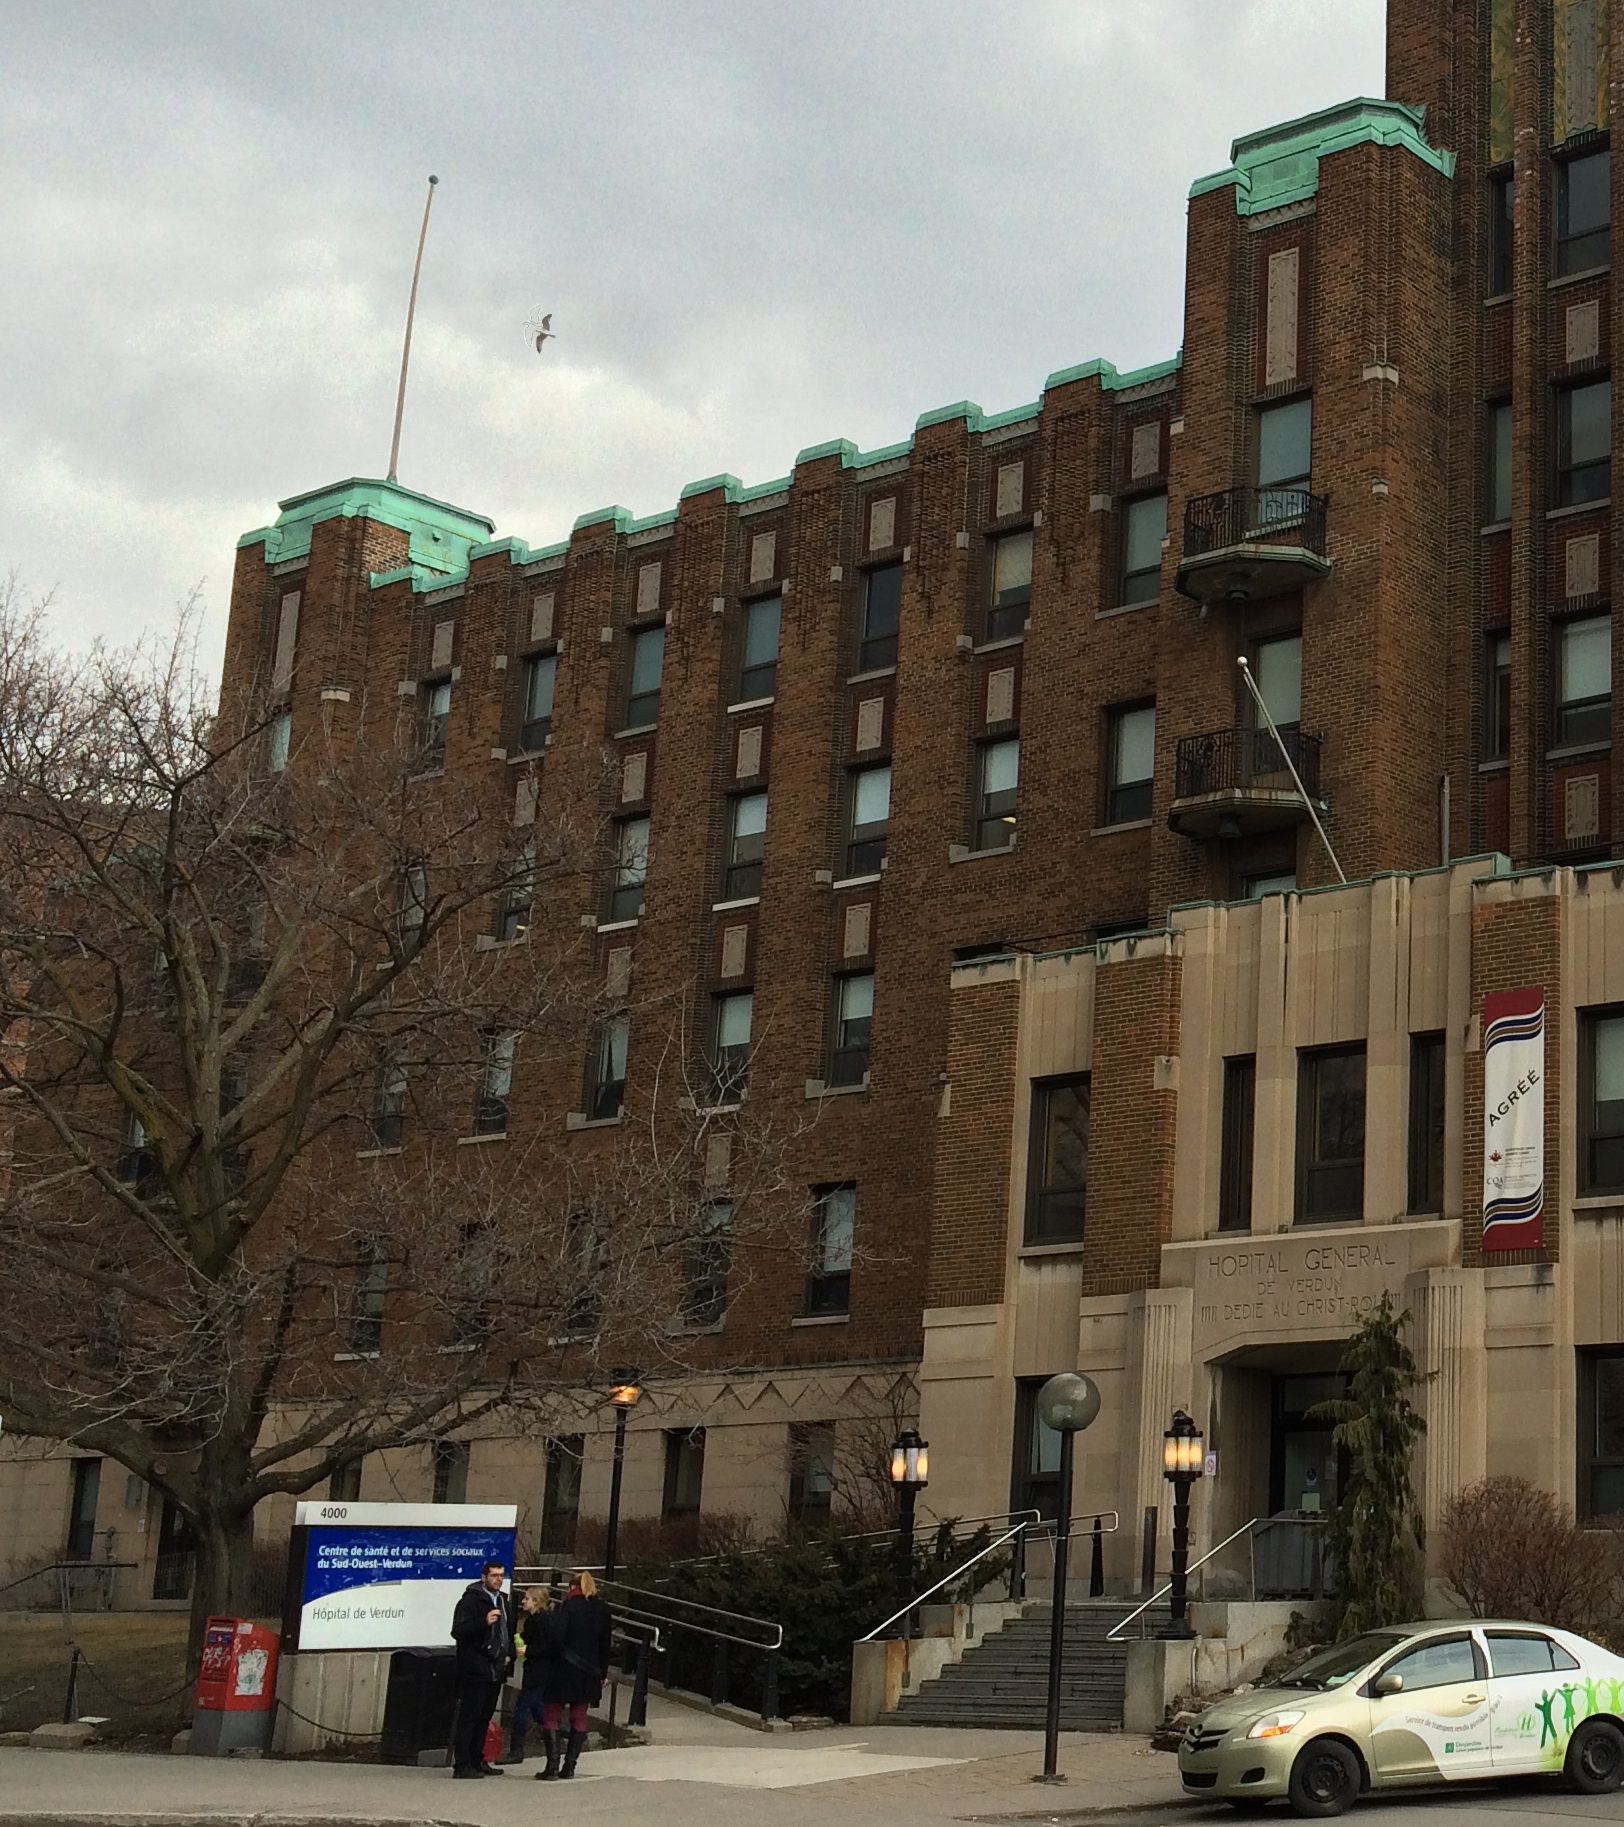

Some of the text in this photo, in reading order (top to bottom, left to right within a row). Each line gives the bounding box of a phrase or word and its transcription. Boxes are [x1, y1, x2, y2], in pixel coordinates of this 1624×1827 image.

[1488, 1069, 1540, 1127] AGRÉÉ
[1208, 1244, 1396, 1279] HOPITAL GENERAL
[1257, 1276, 1343, 1296] DE VERDUN
[1223, 1303, 1264, 1321] DEDIE
[1274, 1303, 1290, 1318] AU
[320, 1507, 348, 1519] 4000
[318, 1545, 483, 1557] Centre de santé et de services sociaux
[317, 1558, 330, 1569] du
[312, 1607, 404, 1622] Hôpital de Verdun
